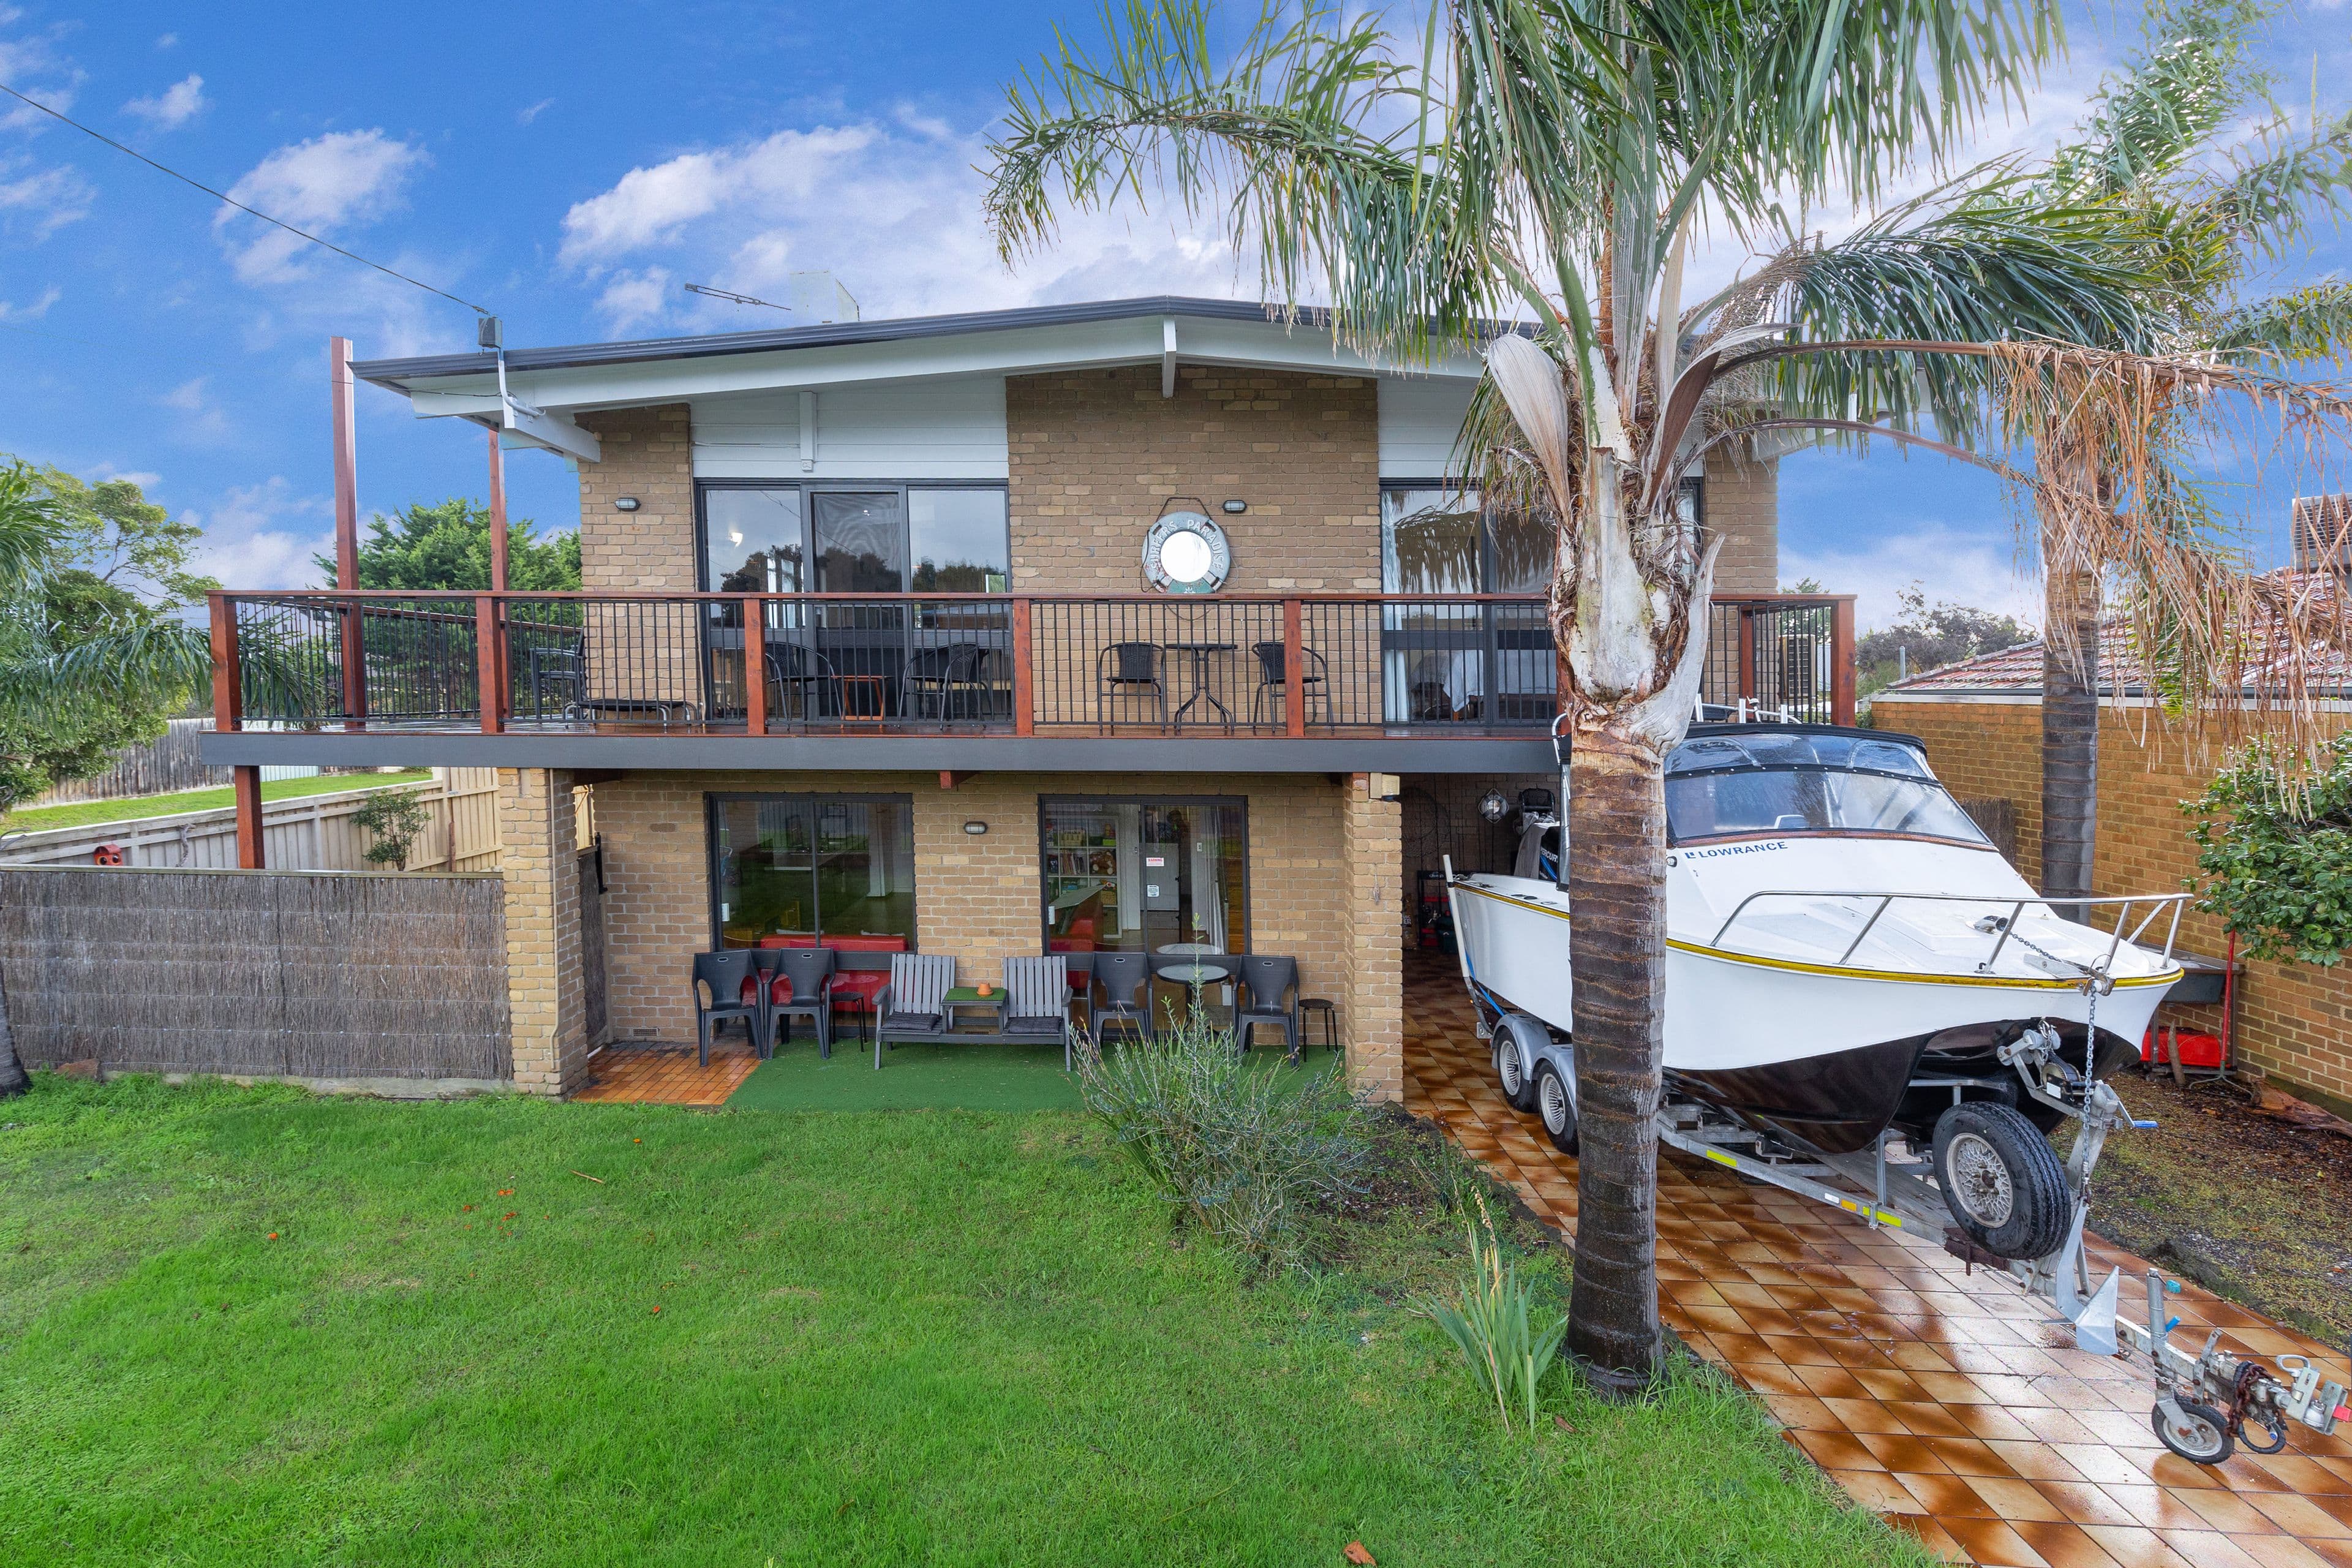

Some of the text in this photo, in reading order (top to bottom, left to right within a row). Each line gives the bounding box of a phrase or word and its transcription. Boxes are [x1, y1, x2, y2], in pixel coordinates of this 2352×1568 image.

[1150, 519, 1224, 570] SURFERS PARADISE
[1698, 841, 1788, 858] LOWRANCE
